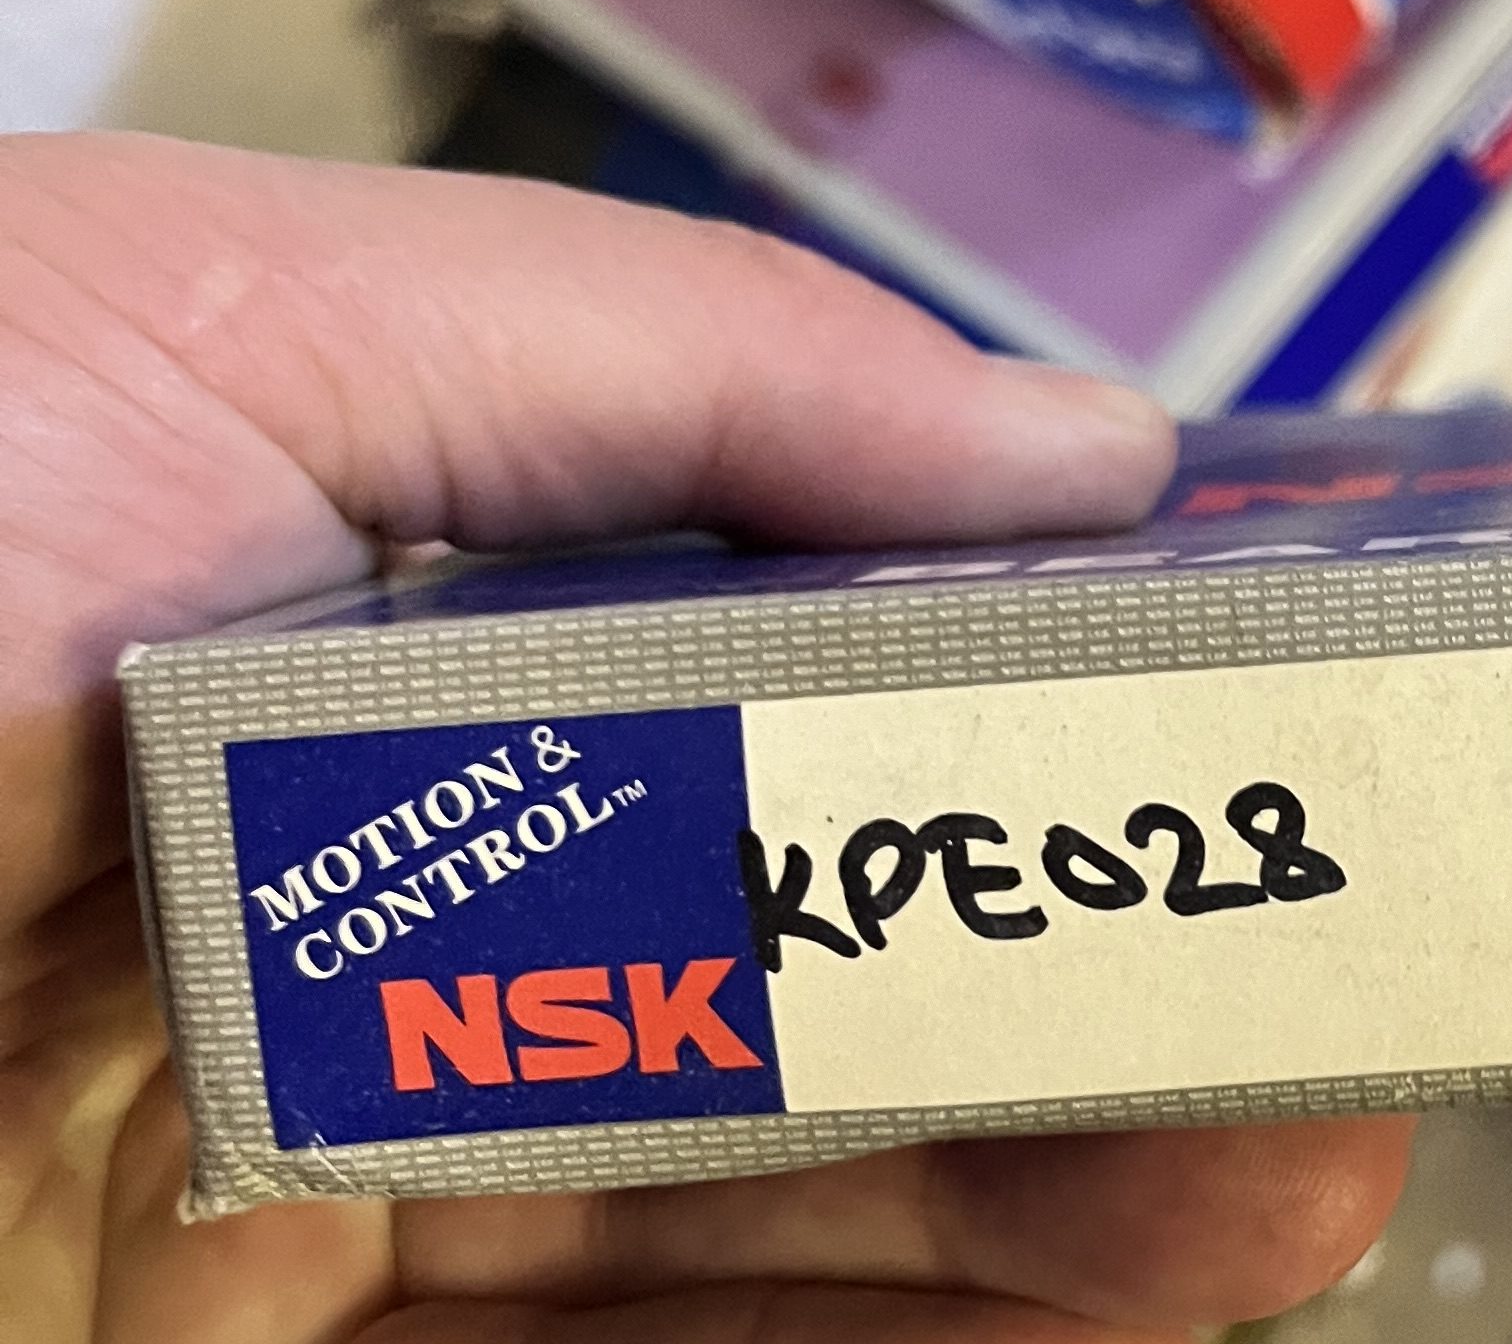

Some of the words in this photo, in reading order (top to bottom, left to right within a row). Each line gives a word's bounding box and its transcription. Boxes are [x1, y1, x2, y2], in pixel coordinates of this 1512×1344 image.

[250, 746, 525, 932] MOTION
[529, 725, 582, 773] &
[378, 956, 765, 1092] NSK
